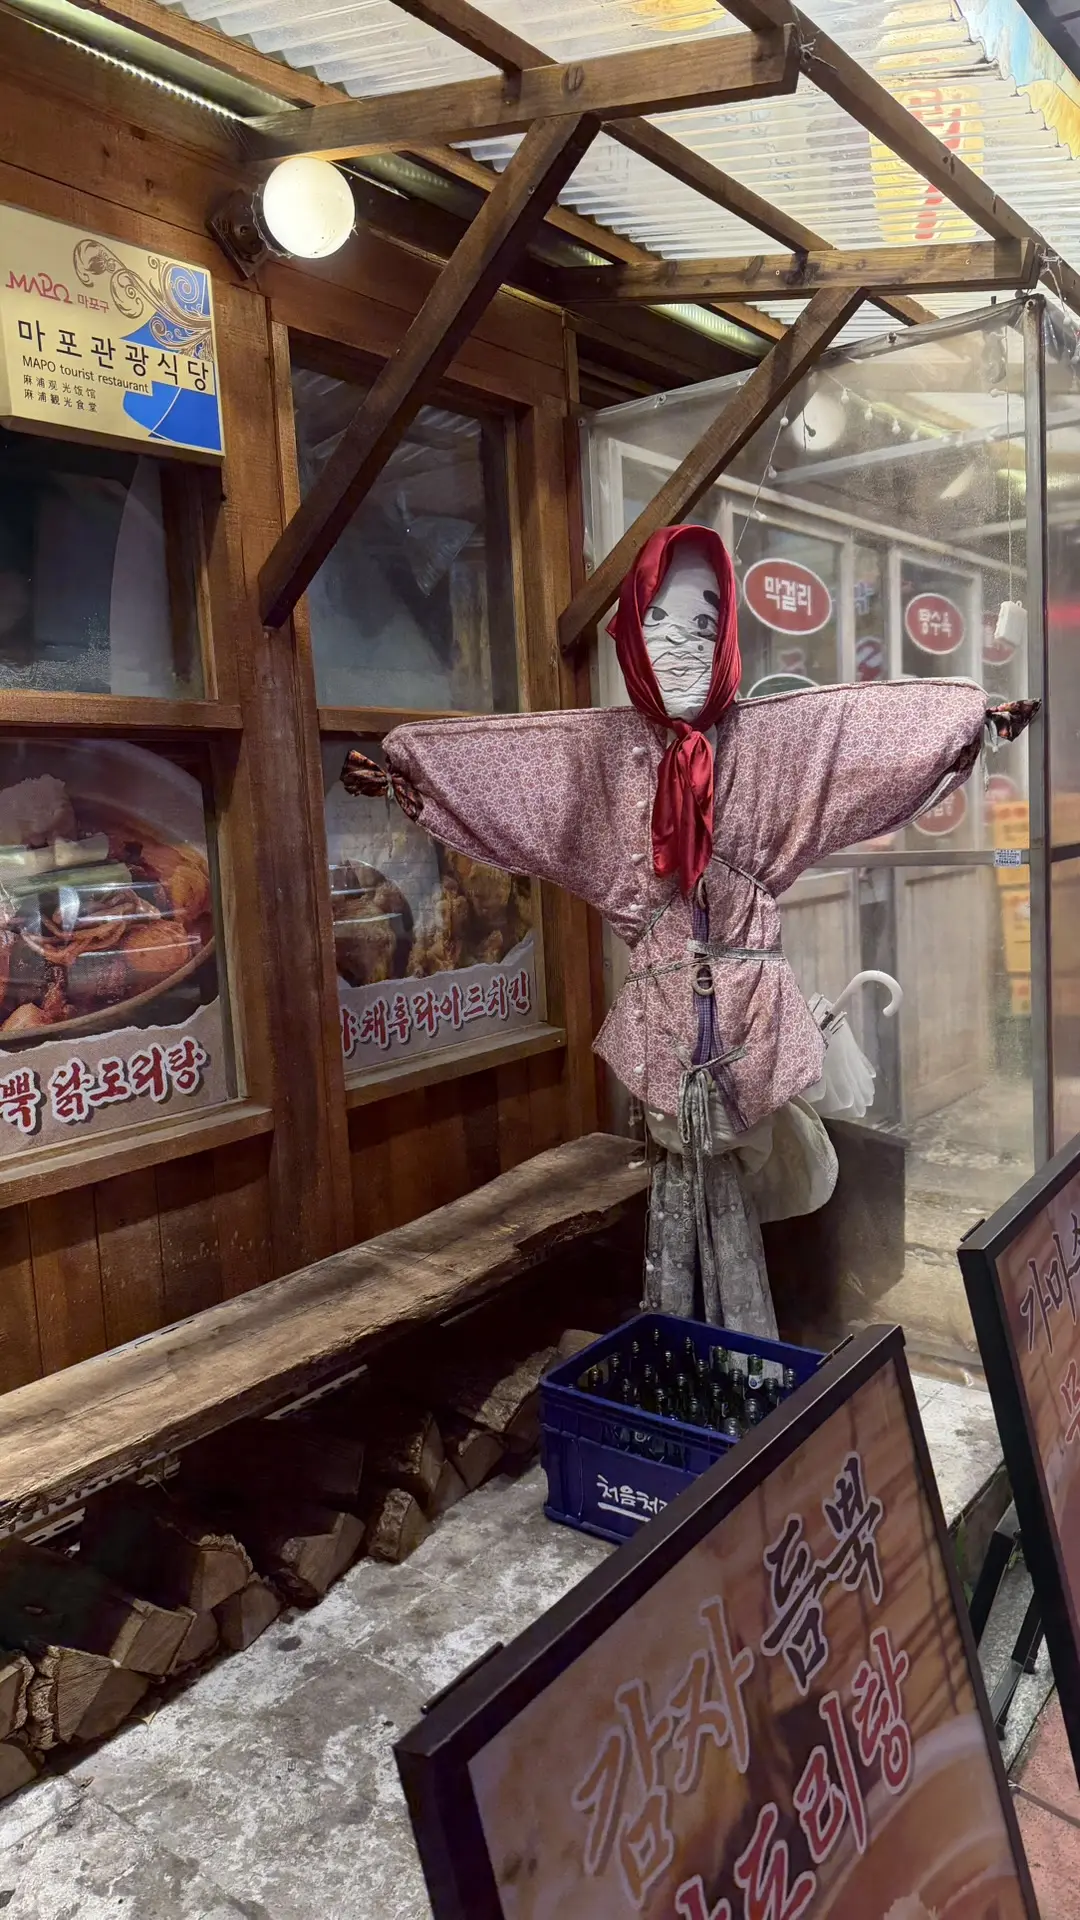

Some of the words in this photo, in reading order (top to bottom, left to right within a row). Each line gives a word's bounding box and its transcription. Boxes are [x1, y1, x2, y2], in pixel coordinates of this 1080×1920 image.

[5, 270, 73, 305] MAPO
[77, 293, 110, 313] 마포구
[18, 319, 209, 391] 마포관광식당
[22, 355, 56, 373] MAPO
[60, 362, 95, 382] tourist
[97, 373, 149, 393] restaurant
[23, 374, 97, 399] 麻浦观光饭馆
[764, 575, 812, 616] 막걸리
